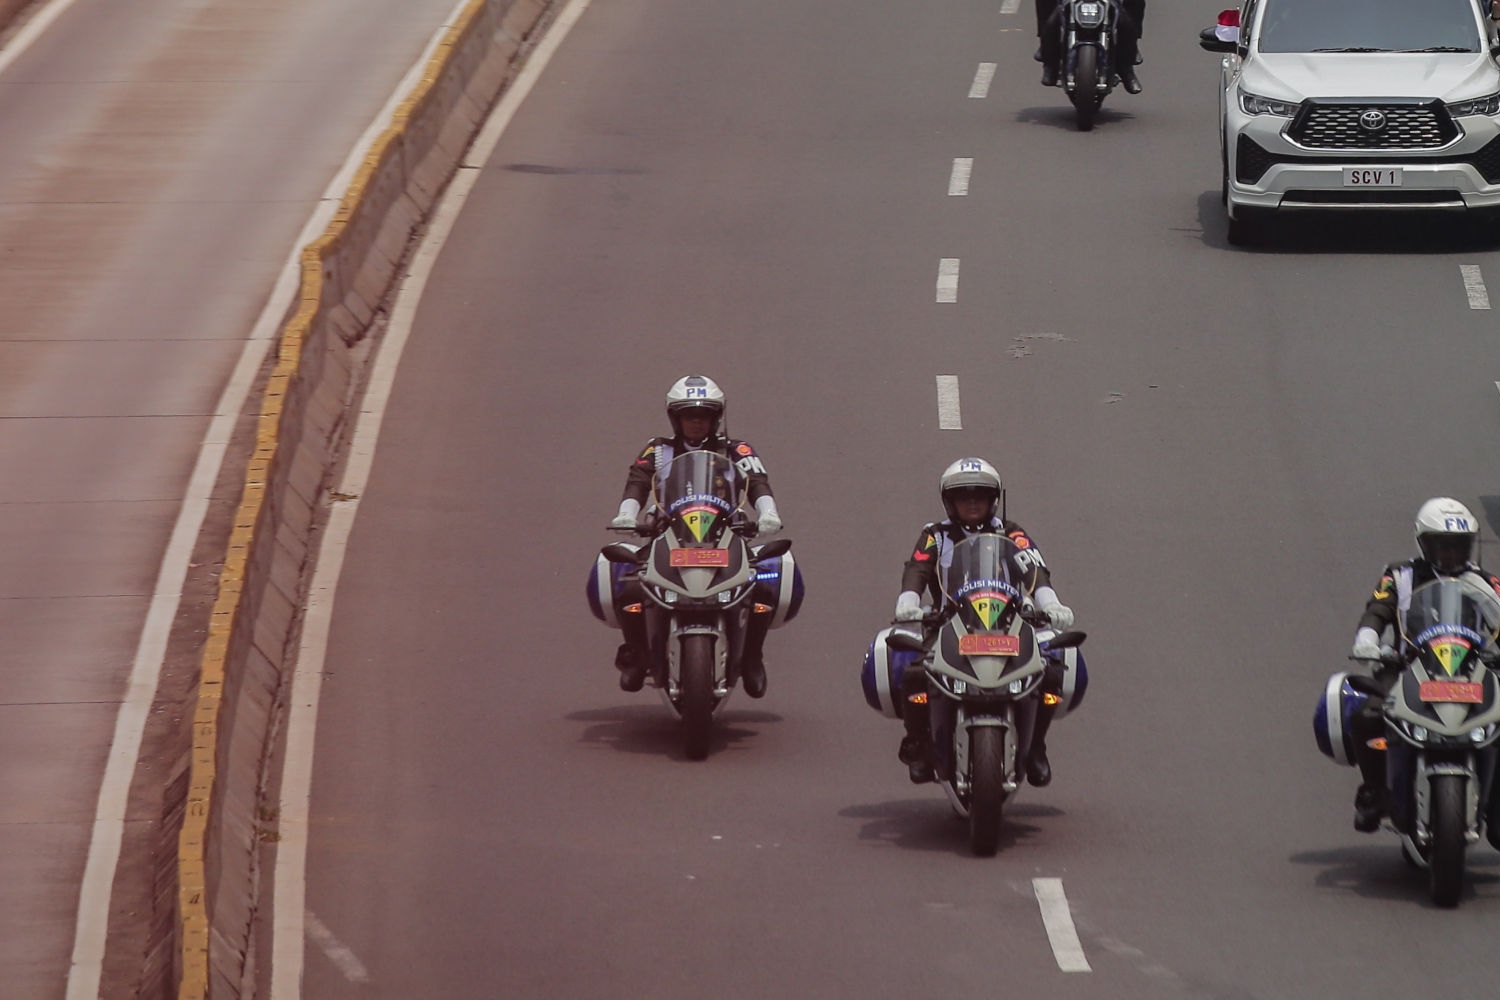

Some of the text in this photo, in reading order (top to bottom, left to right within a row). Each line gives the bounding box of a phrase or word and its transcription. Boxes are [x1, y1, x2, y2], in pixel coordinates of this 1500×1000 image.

[1351, 170, 1395, 184] SCV 1
[686, 387, 707, 398] PM
[735, 456, 767, 480] PM
[960, 461, 982, 472] PM
[670, 494, 697, 511] POLISI
[698, 494, 731, 511] MILITER
[690, 515, 710, 525] PM
[1013, 548, 1046, 575] PM
[957, 580, 985, 597] POLISI
[978, 602, 1000, 613] PM
